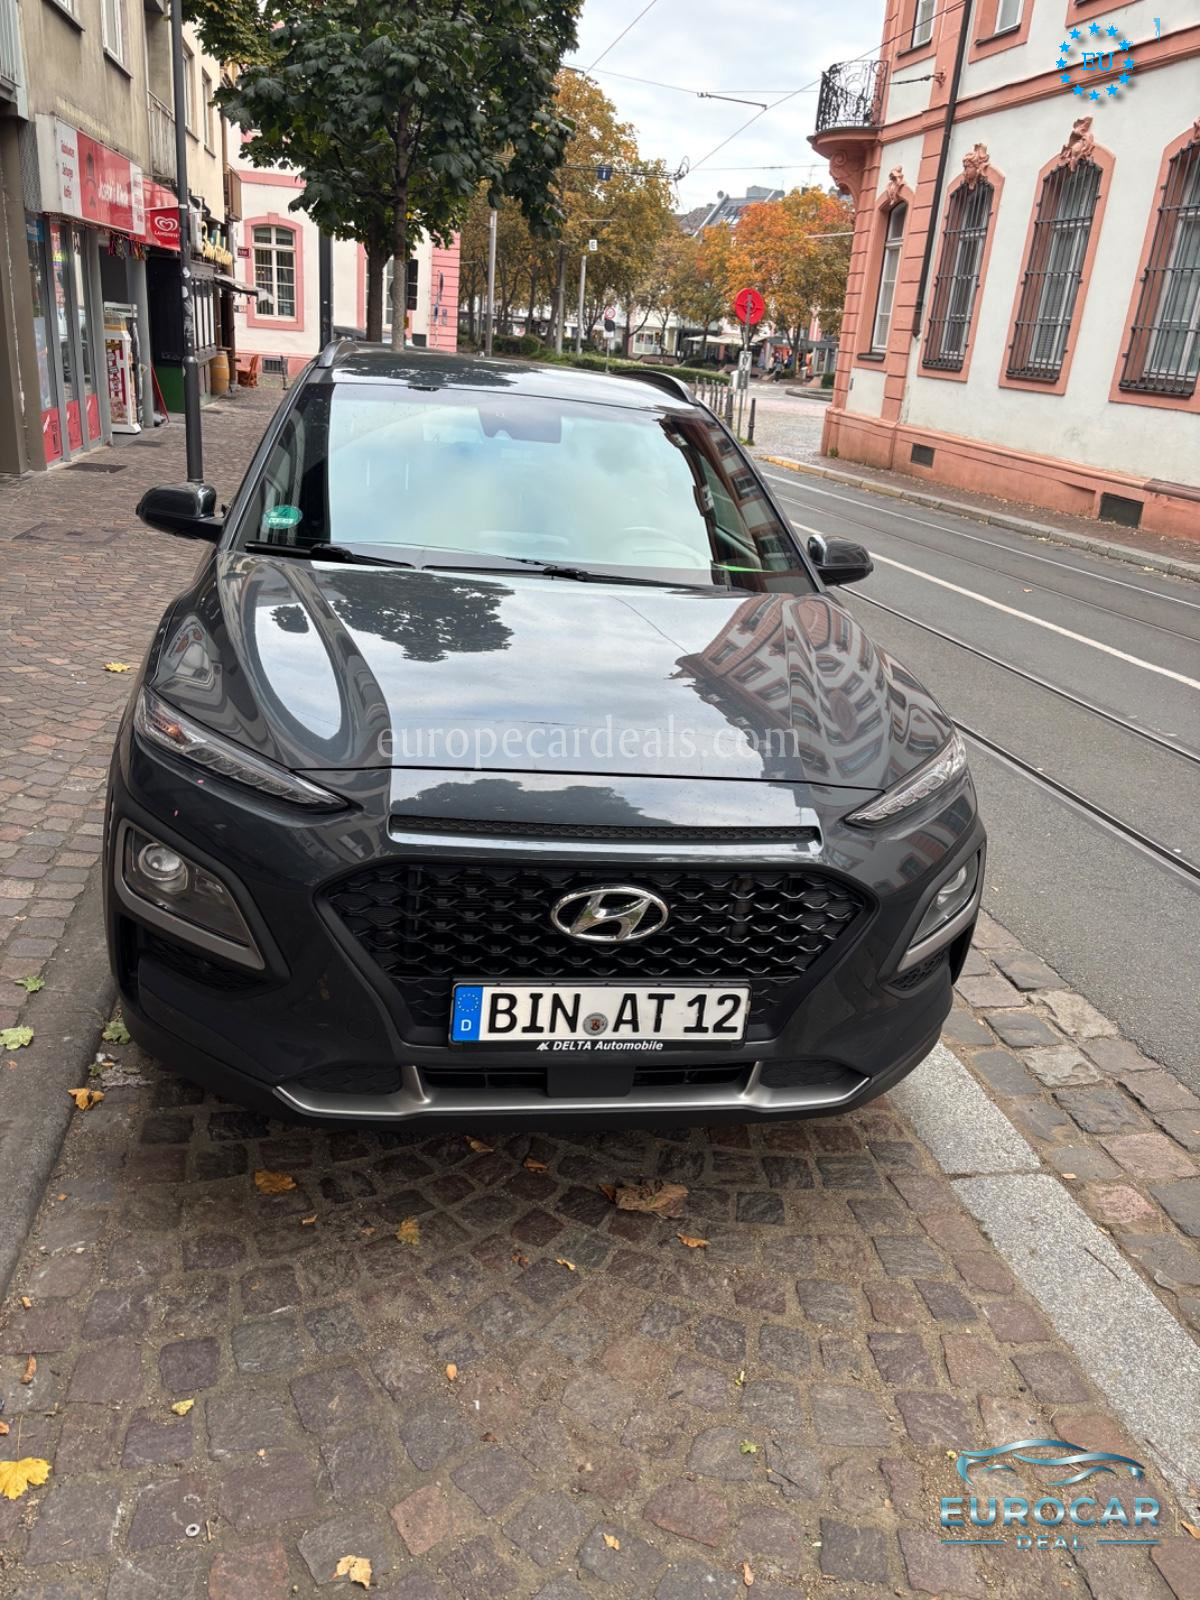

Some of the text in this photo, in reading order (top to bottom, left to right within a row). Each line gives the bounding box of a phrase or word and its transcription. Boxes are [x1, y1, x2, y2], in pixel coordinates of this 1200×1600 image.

[488, 992, 581, 1034] BIN
[461, 1019, 472, 1032] D
[553, 1040, 663, 1051] DELTA Automobile
